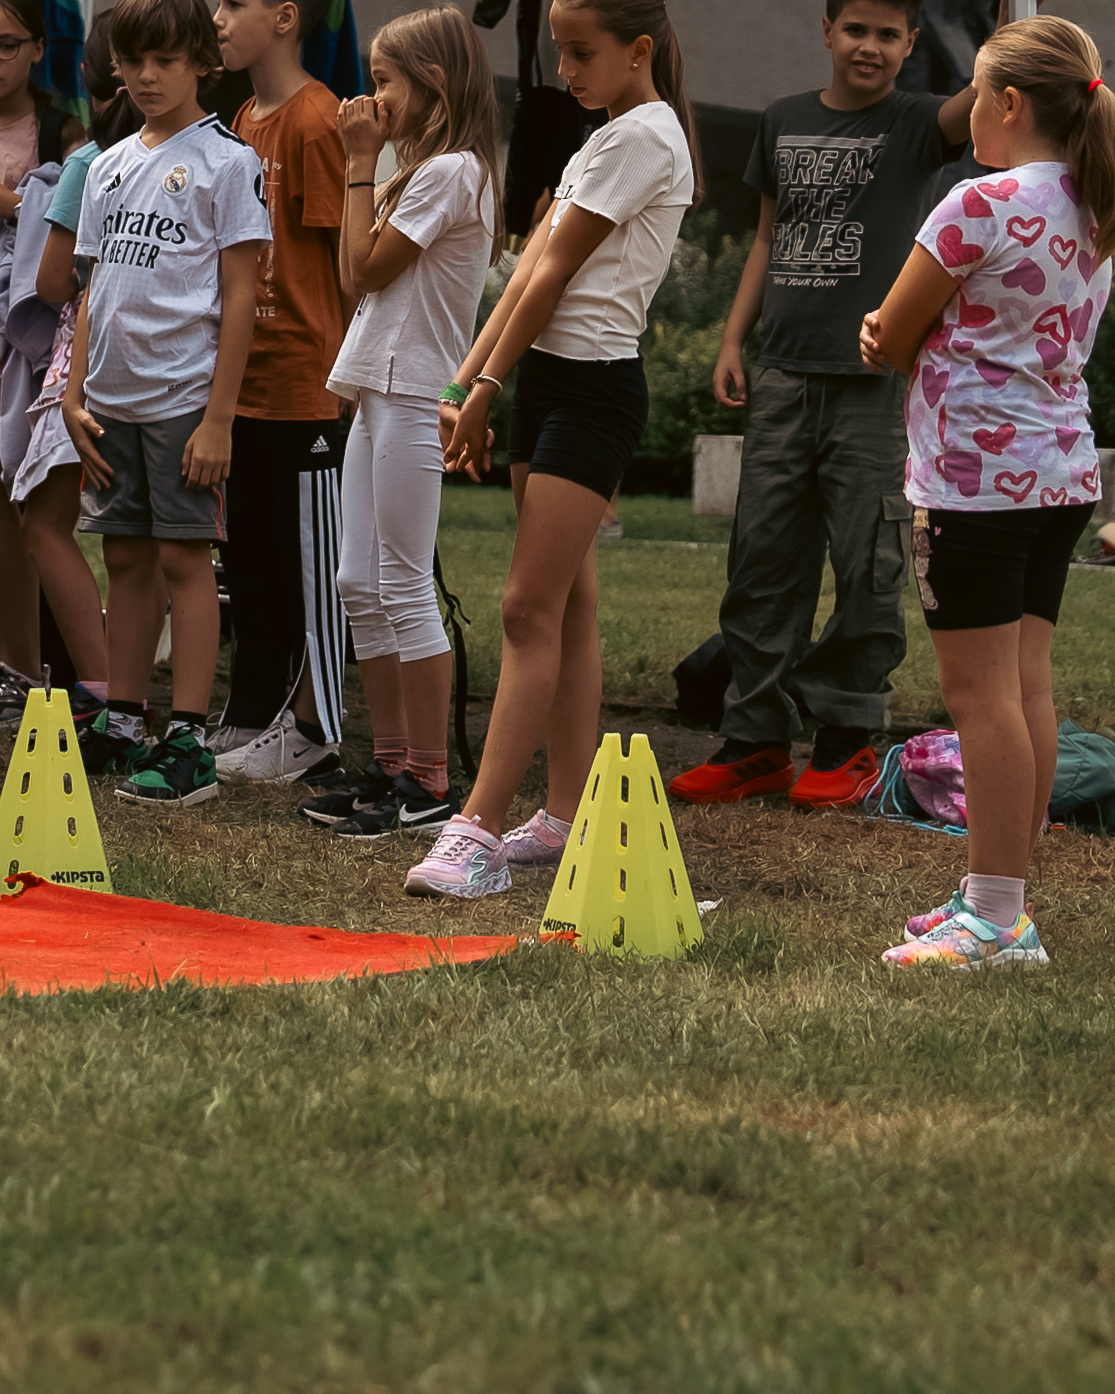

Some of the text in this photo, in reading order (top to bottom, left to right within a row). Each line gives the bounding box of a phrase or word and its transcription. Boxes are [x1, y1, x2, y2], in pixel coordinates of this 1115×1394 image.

[774, 147, 884, 186] BREAK
[102, 202, 189, 245] mirates
[788, 186, 852, 224] THE
[108, 238, 161, 269] BETTER
[771, 221, 864, 262] RULES
[787, 276, 812, 286] YOUR
[813, 277, 839, 288] OWN
